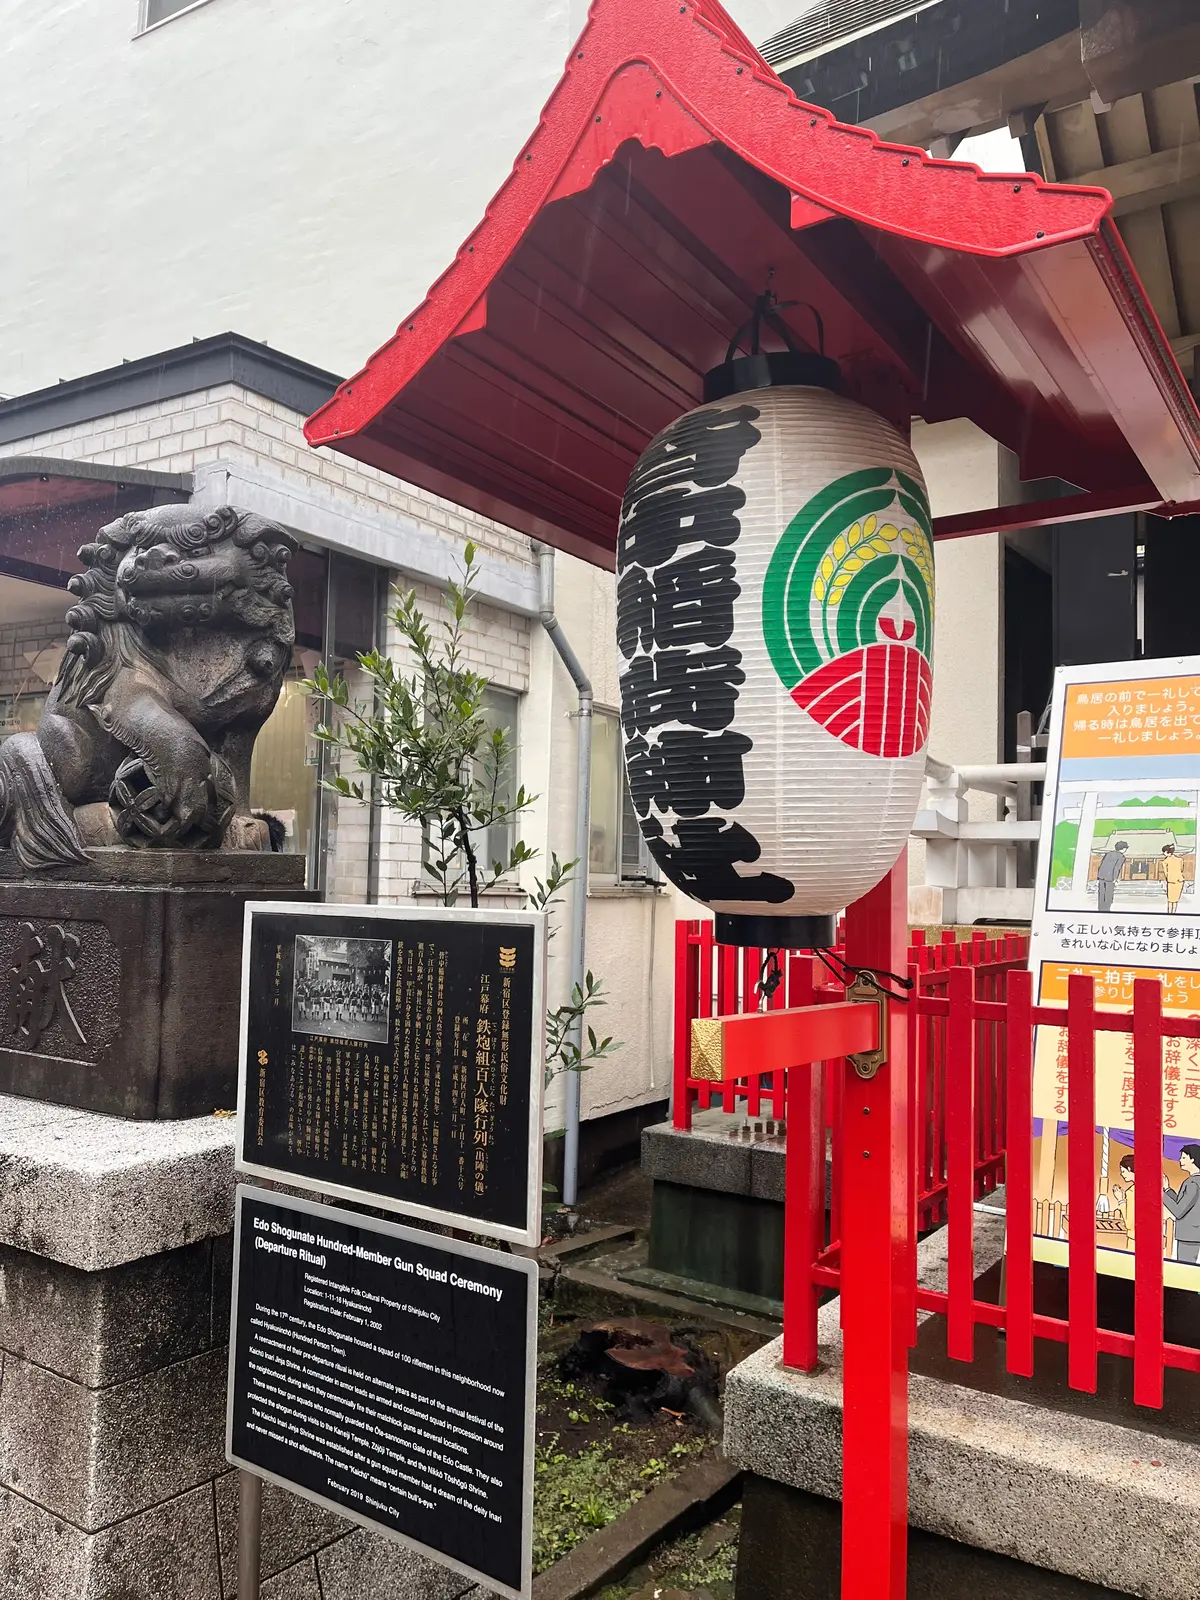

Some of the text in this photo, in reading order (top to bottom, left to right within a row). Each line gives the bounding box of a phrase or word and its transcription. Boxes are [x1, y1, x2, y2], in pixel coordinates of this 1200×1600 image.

[1107, 700, 1196, 717] 入りましょう。
[1098, 728, 1200, 744] 一礼しましょう。
[1061, 938, 1198, 955] きれいな心になりましょ
[480, 974, 490, 1014] 江戸幕府
[254, 1217, 503, 1302] Edo Shogunate Hundred-Member Gun Squad Ceremony
[255, 1236, 326, 1269] (Departure Ritual)
[304, 1285, 323, 1297] Location:
[305, 1273, 328, 1286] Registered
[329, 1280, 350, 1293] Intangible
[351, 1287, 361, 1296] Folk
[362, 1291, 380, 1302] Cultural
[381, 1297, 401, 1310] Property
[408, 1305, 429, 1318] Shinjuku
[430, 1312, 440, 1323] City
[304, 1298, 329, 1313] Registration
[330, 1307, 342, 1317] Date:
[343, 1311, 364, 1326] February
[370, 1321, 382, 1331] 2002
[250, 1318, 263, 1327] called
[292, 1331, 313, 1344] (Hundred
[313, 1338, 330, 1350] Person
[331, 1344, 346, 1357] Town).
[256, 1303, 270, 1316] During
[271, 1309, 279, 1317] the
[289, 1316, 307, 1328] century,
[308, 1322, 316, 1330] the
[317, 1324, 327, 1333] Edo
[327, 1328, 353, 1343] Shogunate
[354, 1337, 372, 1350] housed
[378, 1347, 394, 1357] squad
[401, 1354, 411, 1363] 100
[412, 1358, 434, 1371] riflemen
[441, 1368, 451, 1378] this
[452, 1374, 491, 1392] neighborhood
[492, 1388, 505, 1397] now
[256, 1365, 287, 1382] neighborhood,
[287, 1377, 302, 1389] during
[302, 1383, 315, 1393] which
[316, 1387, 326, 1398] they
[327, 1393, 356, 1410] ceremonially
[357, 1403, 365, 1412] fire
[366, 1407, 377, 1417] their
[377, 1413, 402, 1428] matchlock
[403, 1423, 416, 1433] guns
[423, 1431, 443, 1444] several
[443, 1438, 469, 1455] locations.
[265, 1352, 275, 1361] Inari
[275, 1356, 285, 1366] Jinja
[286, 1360, 301, 1371] Shrine.
[307, 1369, 334, 1383] commander
[340, 1382, 354, 1391] armor
[355, 1386, 368, 1397] leads
[376, 1396, 392, 1407] armed
[393, 1402, 403, 1411] and
[403, 1406, 429, 1421] costumed
[429, 1416, 446, 1428] squad
[453, 1426, 483, 1443] procession
[484, 1438, 504, 1451] around
[292, 1347, 303, 1356] their
[303, 1352, 334, 1368] pre-departure
[335, 1363, 347, 1373] ritual
[353, 1369, 364, 1379] held
[372, 1377, 394, 1391] alternate
[395, 1386, 410, 1397] years
[418, 1395, 429, 1404] part
[437, 1401, 445, 1410] the
[446, 1406, 465, 1418] annual
[466, 1412, 486, 1426] festival
[494, 1423, 504, 1433] the
[247, 1392, 268, 1405] protected
[276, 1403, 292, 1414] shogun
[293, 1410, 307, 1422] during
[308, 1416, 319, 1426] visits
[351, 1433, 370, 1449] Temple,
[386, 1448, 406, 1464] Temple,
[407, 1459, 418, 1468] and
[418, 1462, 427, 1472] the
[468, 1484, 488, 1499] Shrine.
[253, 1377, 265, 1389] There
[266, 1385, 277, 1393] were
[278, 1388, 287, 1396] four
[297, 1396, 313, 1408] squads
[314, 1403, 323, 1412] who
[324, 1408, 344, 1422] normally
[345, 1416, 365, 1429] guarded
[366, 1424, 374, 1433] the
[412, 1443, 426, 1454] Gate
[433, 1451, 442, 1461] the
[443, 1455, 454, 1466] Edo
[455, 1460, 474, 1475] Castle.
[475, 1469, 490, 1483] They
[491, 1477, 503, 1487] also
[328, 1478, 400, 1518] February 2019 Shinjuku City
